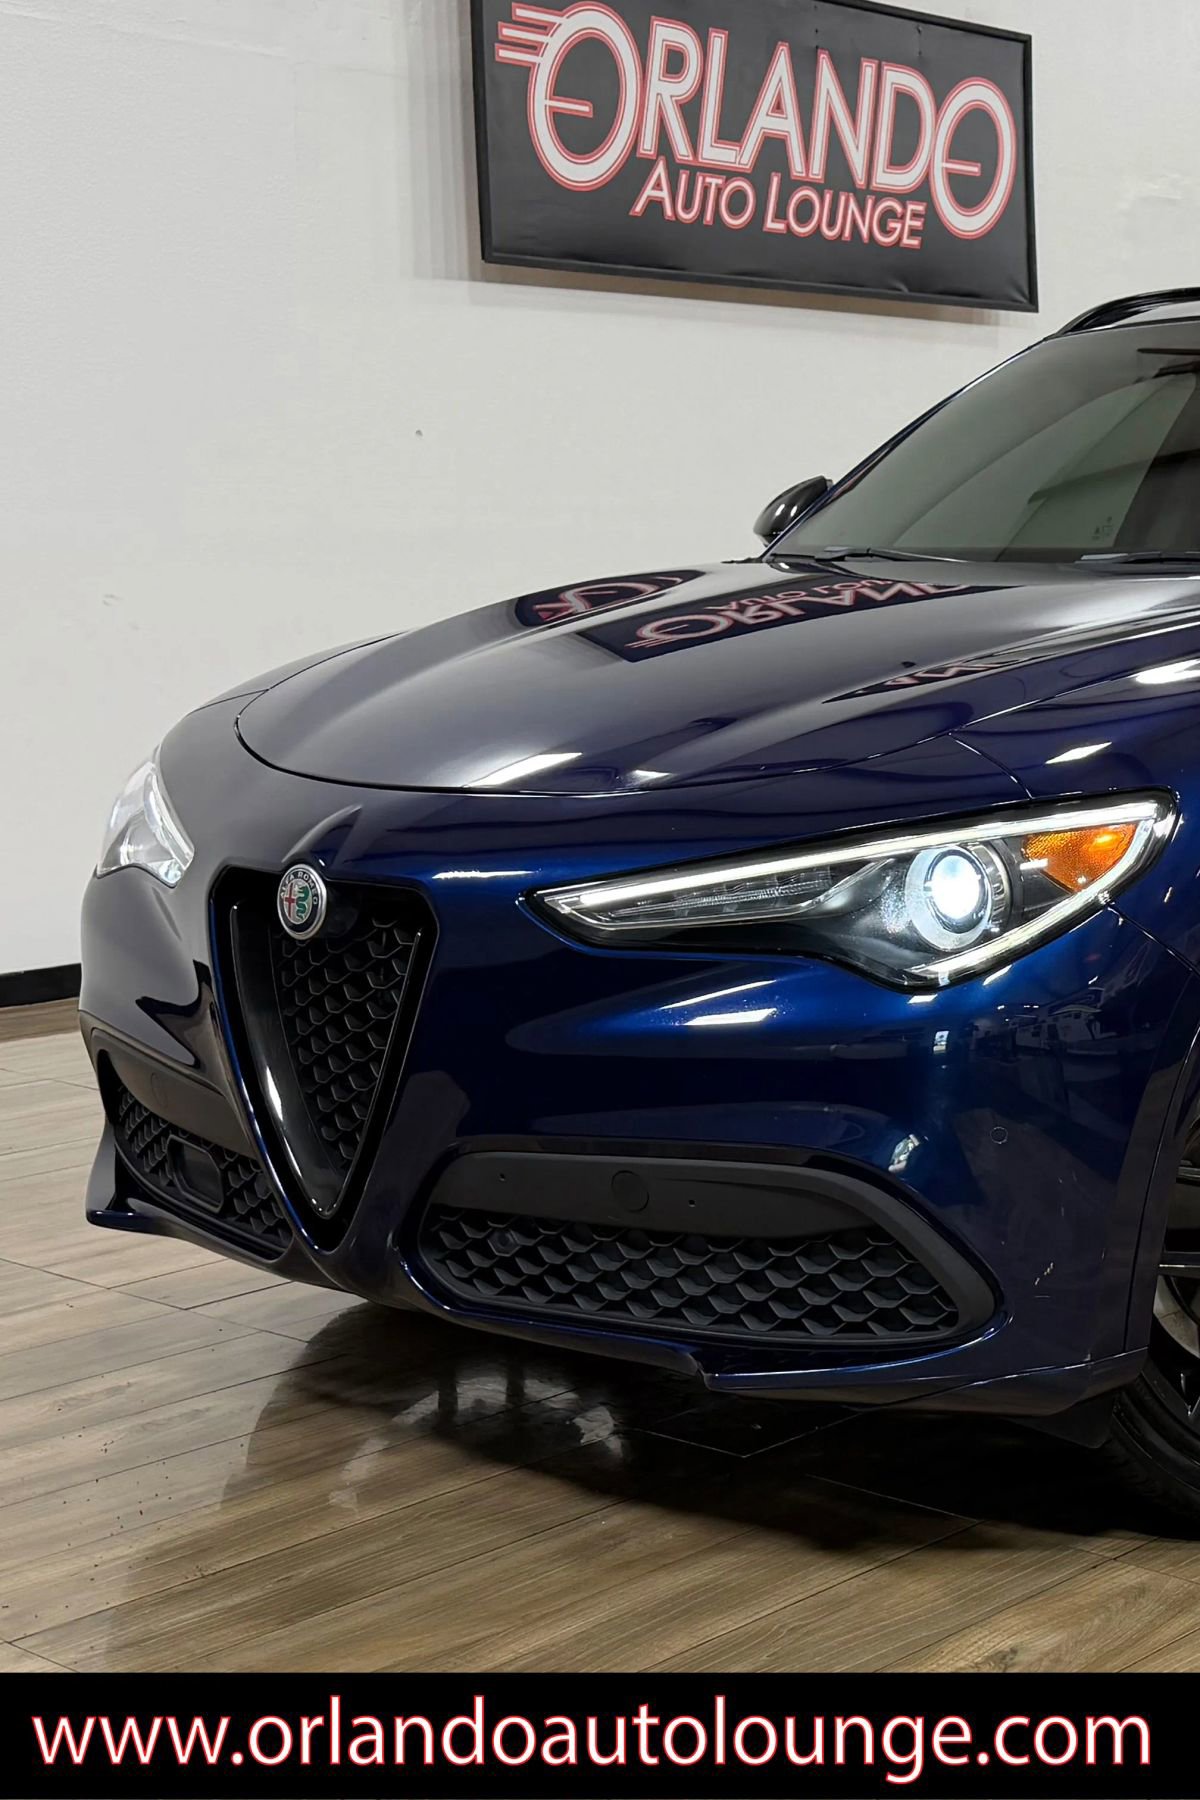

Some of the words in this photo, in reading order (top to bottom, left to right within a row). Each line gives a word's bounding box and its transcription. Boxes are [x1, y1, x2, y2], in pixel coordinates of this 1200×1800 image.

[496, 1, 1016, 240] ORLANDO
[629, 156, 756, 229] AUTO
[762, 172, 926, 249] LOUNGE
[297, 871, 319, 905] ROMEO
